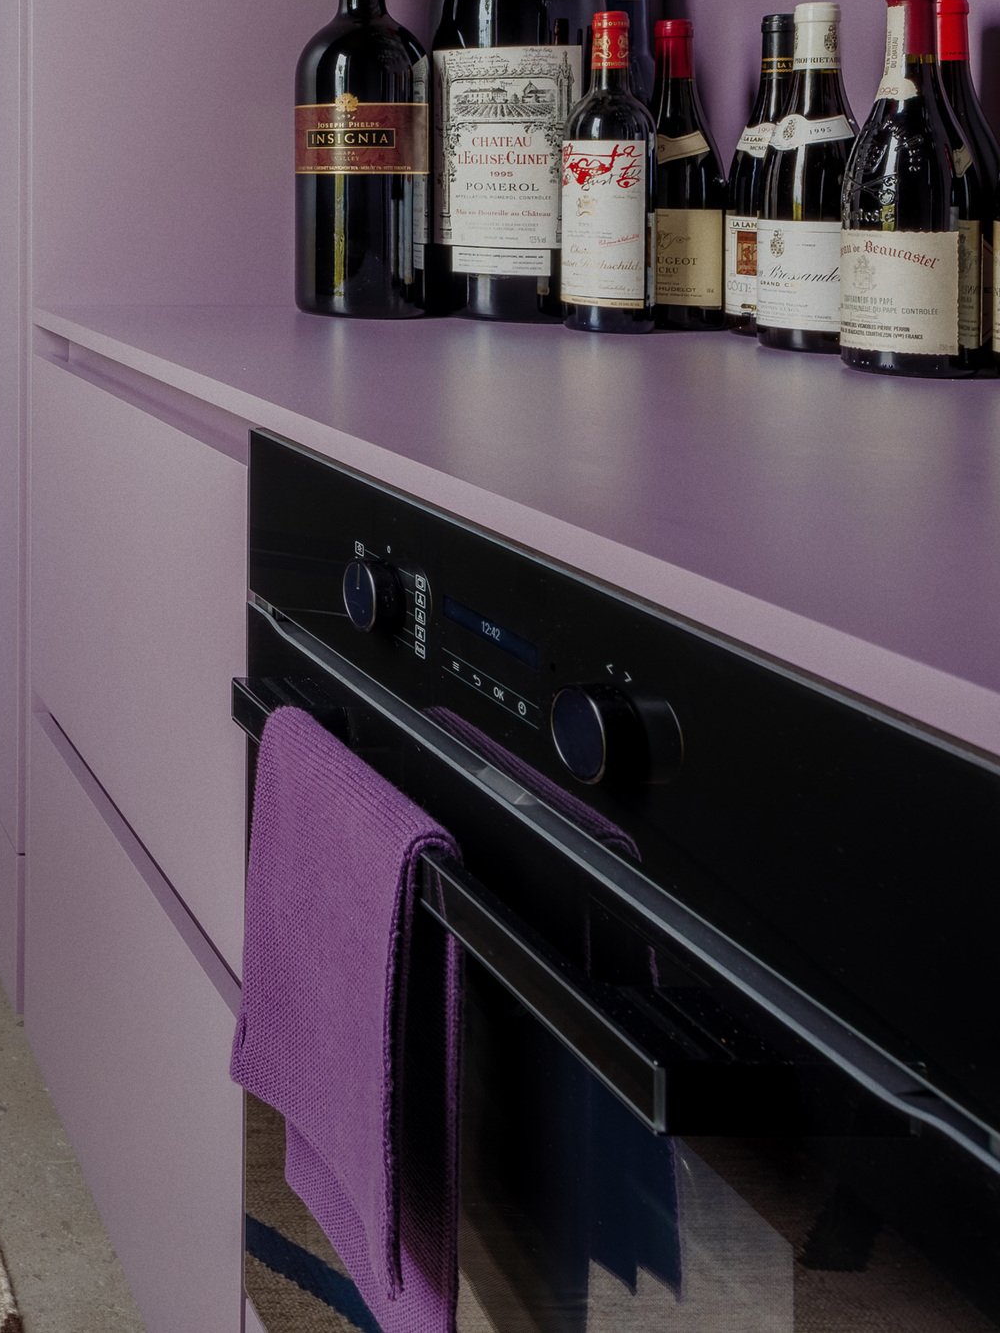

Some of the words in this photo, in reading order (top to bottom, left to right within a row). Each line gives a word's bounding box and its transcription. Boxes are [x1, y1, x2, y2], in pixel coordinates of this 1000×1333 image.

[879, 86, 899, 96] 995
[809, 126, 832, 135] 1995
[311, 132, 389, 144] INSIGNIA
[471, 136, 532, 147] CHATEAU
[466, 182, 540, 192] POMEROL
[657, 256, 698, 266] UGEOT
[658, 266, 679, 274] CRU
[879, 297, 894, 306] PAPE
[872, 305, 881, 313] DU
[481, 620, 501, 642] 12:42
[493, 686, 505, 702] OK
